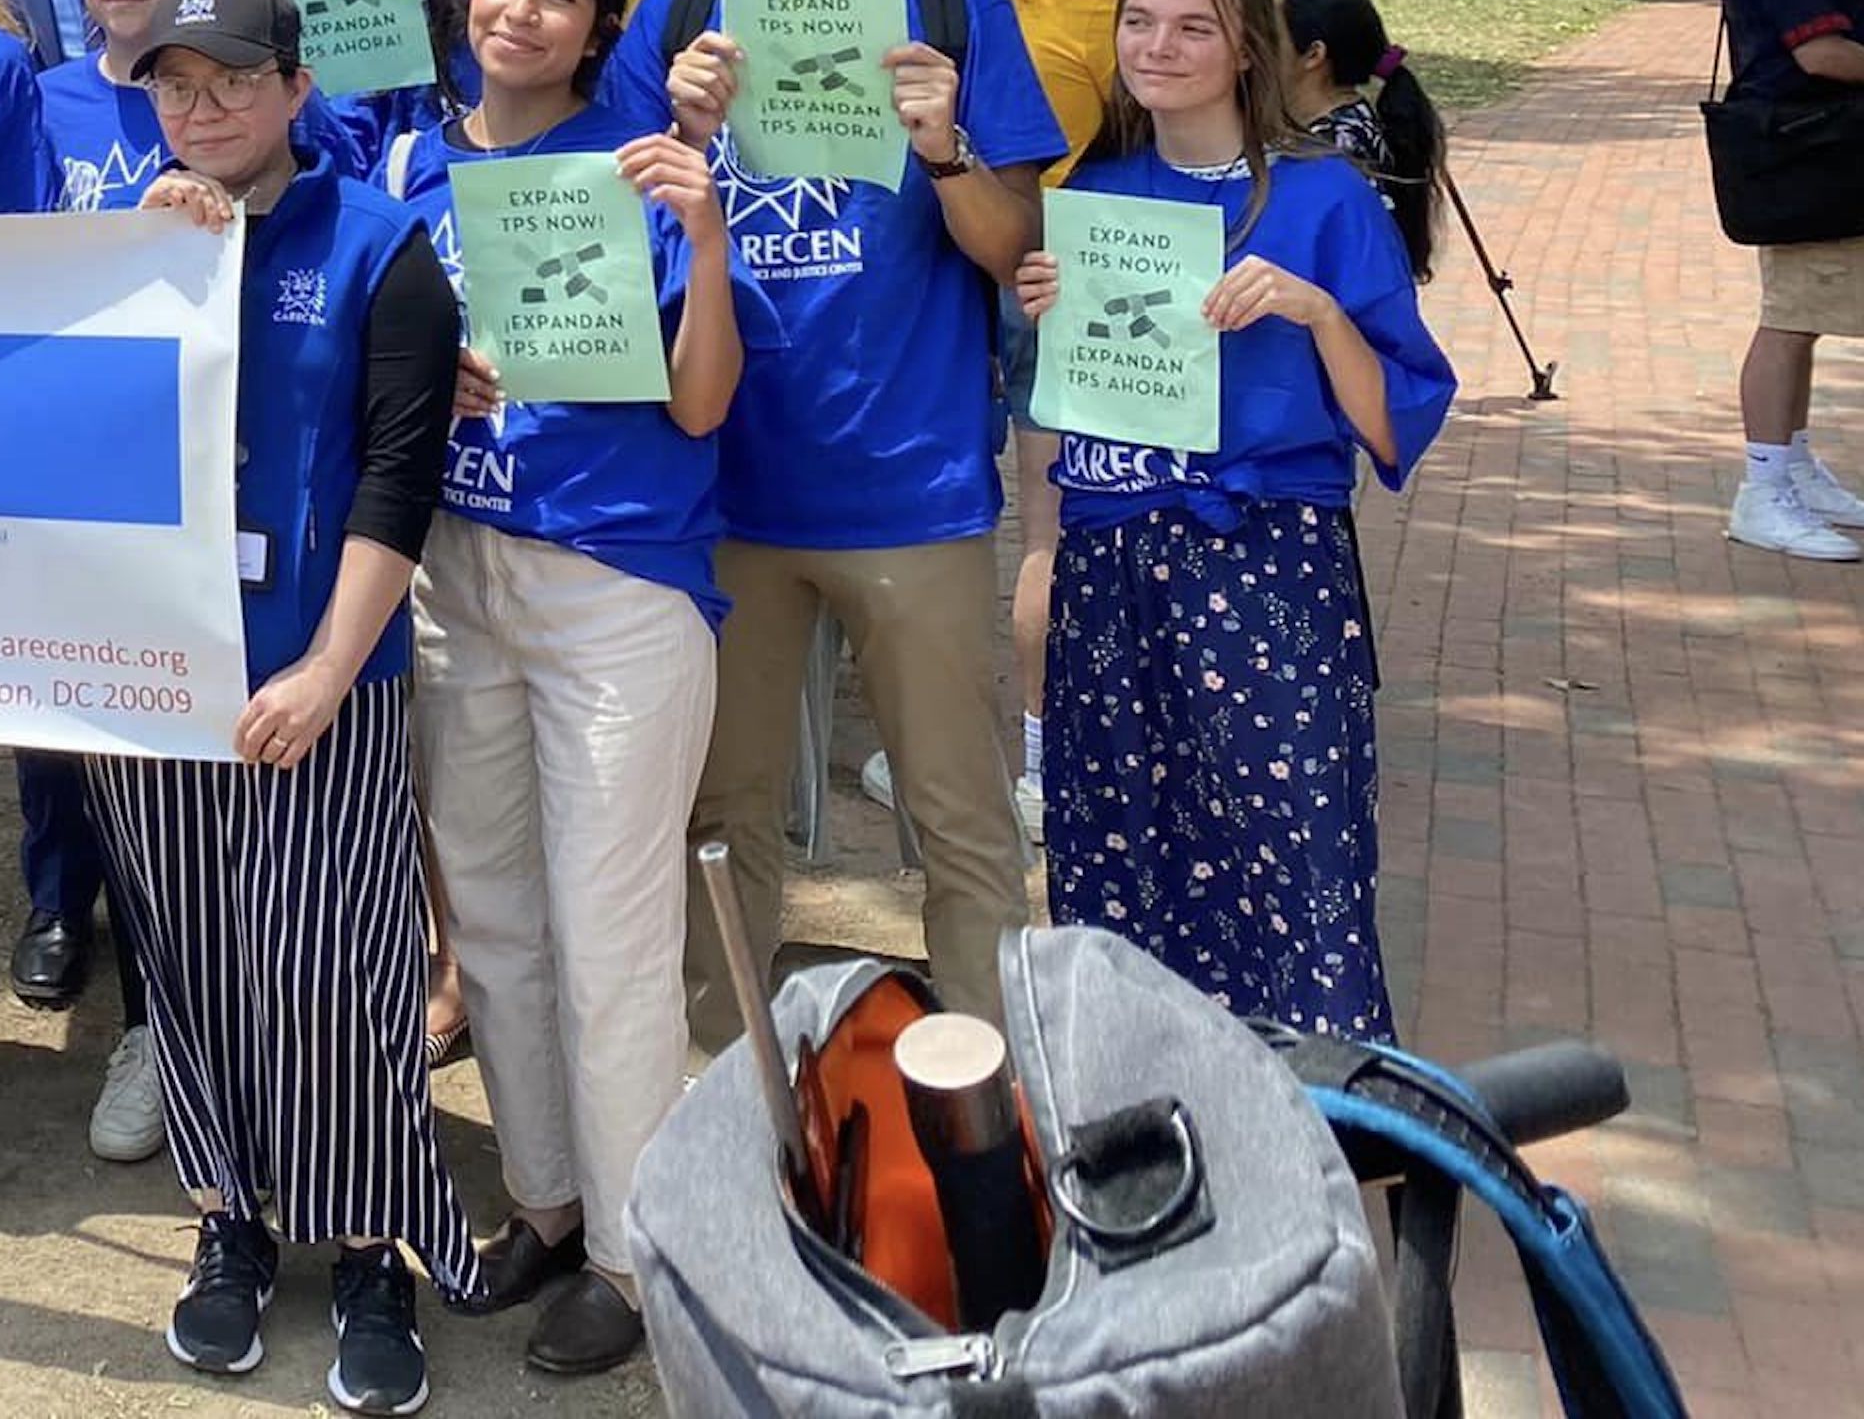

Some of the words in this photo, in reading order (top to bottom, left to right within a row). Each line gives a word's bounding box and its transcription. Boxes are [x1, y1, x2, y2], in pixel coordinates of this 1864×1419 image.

[302, 12, 396, 38] EXPANDAN
[759, 18, 794, 35] TPS
[802, 19, 864, 36] NOW!
[304, 44, 326, 59] PS
[333, 33, 403, 56] AHORA!
[760, 120, 797, 134] TPS
[805, 121, 885, 141] AHORA!
[509, 189, 591, 207] EXPAND
[502, 216, 538, 232] TPS
[546, 214, 606, 231] NOW!
[740, 226, 862, 267] RECEN
[1089, 226, 1172, 250] EXPAND
[1078, 251, 1111, 270] TPS
[1119, 256, 1181, 277] NOW!
[503, 340, 538, 357] TPS
[547, 338, 630, 356] AHORA!
[1067, 369, 1100, 389] TPS
[1107, 377, 1186, 401] AHORA!
[52, 681, 94, 709] DC
[102, 684, 194, 715] 20009
